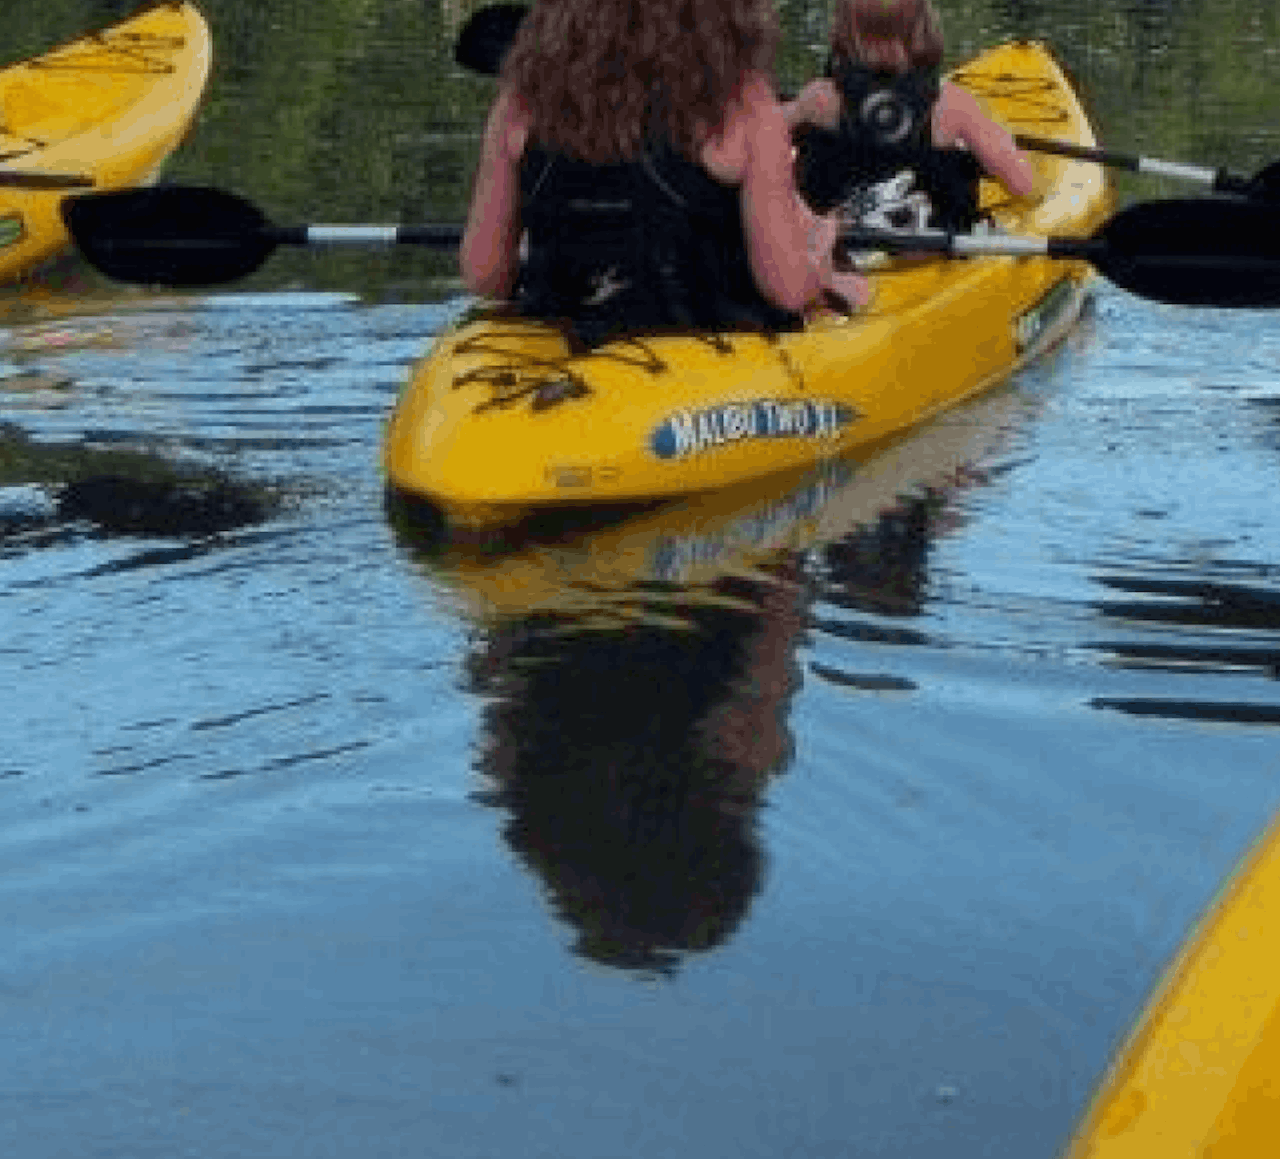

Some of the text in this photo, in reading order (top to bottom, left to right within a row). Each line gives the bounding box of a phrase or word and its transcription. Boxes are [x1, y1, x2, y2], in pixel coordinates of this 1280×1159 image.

[673, 402, 839, 456] MALIBU TWO XL
